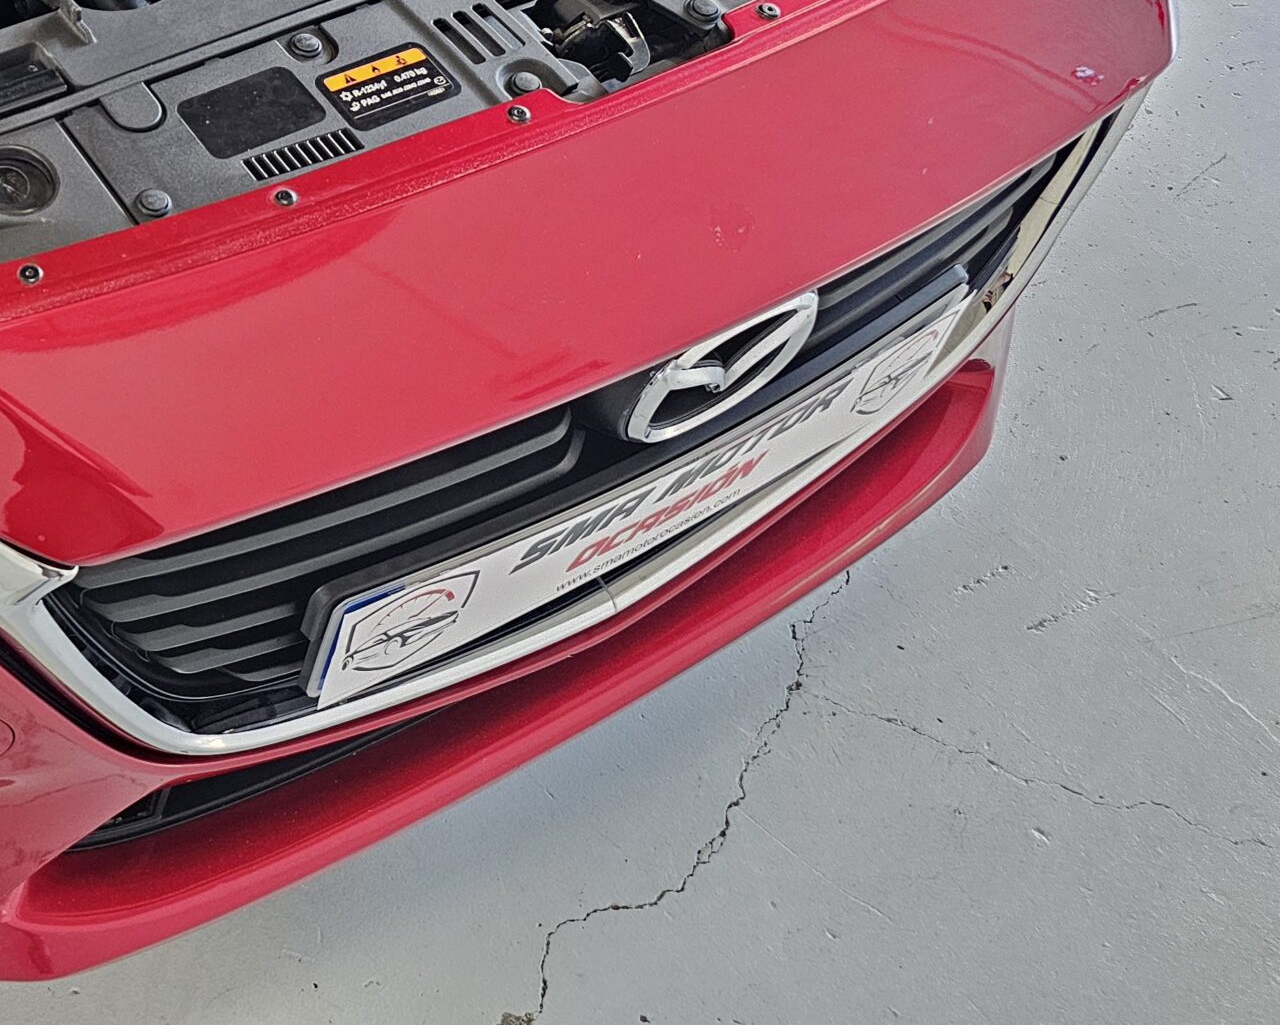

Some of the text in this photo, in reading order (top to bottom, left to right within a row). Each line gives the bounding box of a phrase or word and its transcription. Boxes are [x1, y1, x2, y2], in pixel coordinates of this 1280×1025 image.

[352, 79, 387, 97] R-1234yf
[414, 66, 428, 76] kg
[360, 95, 380, 107] PAG
[509, 377, 853, 575] SMA MOTOR
[566, 450, 769, 572] OCASIÓN
[556, 487, 742, 592] www.smamotorocasion.com
